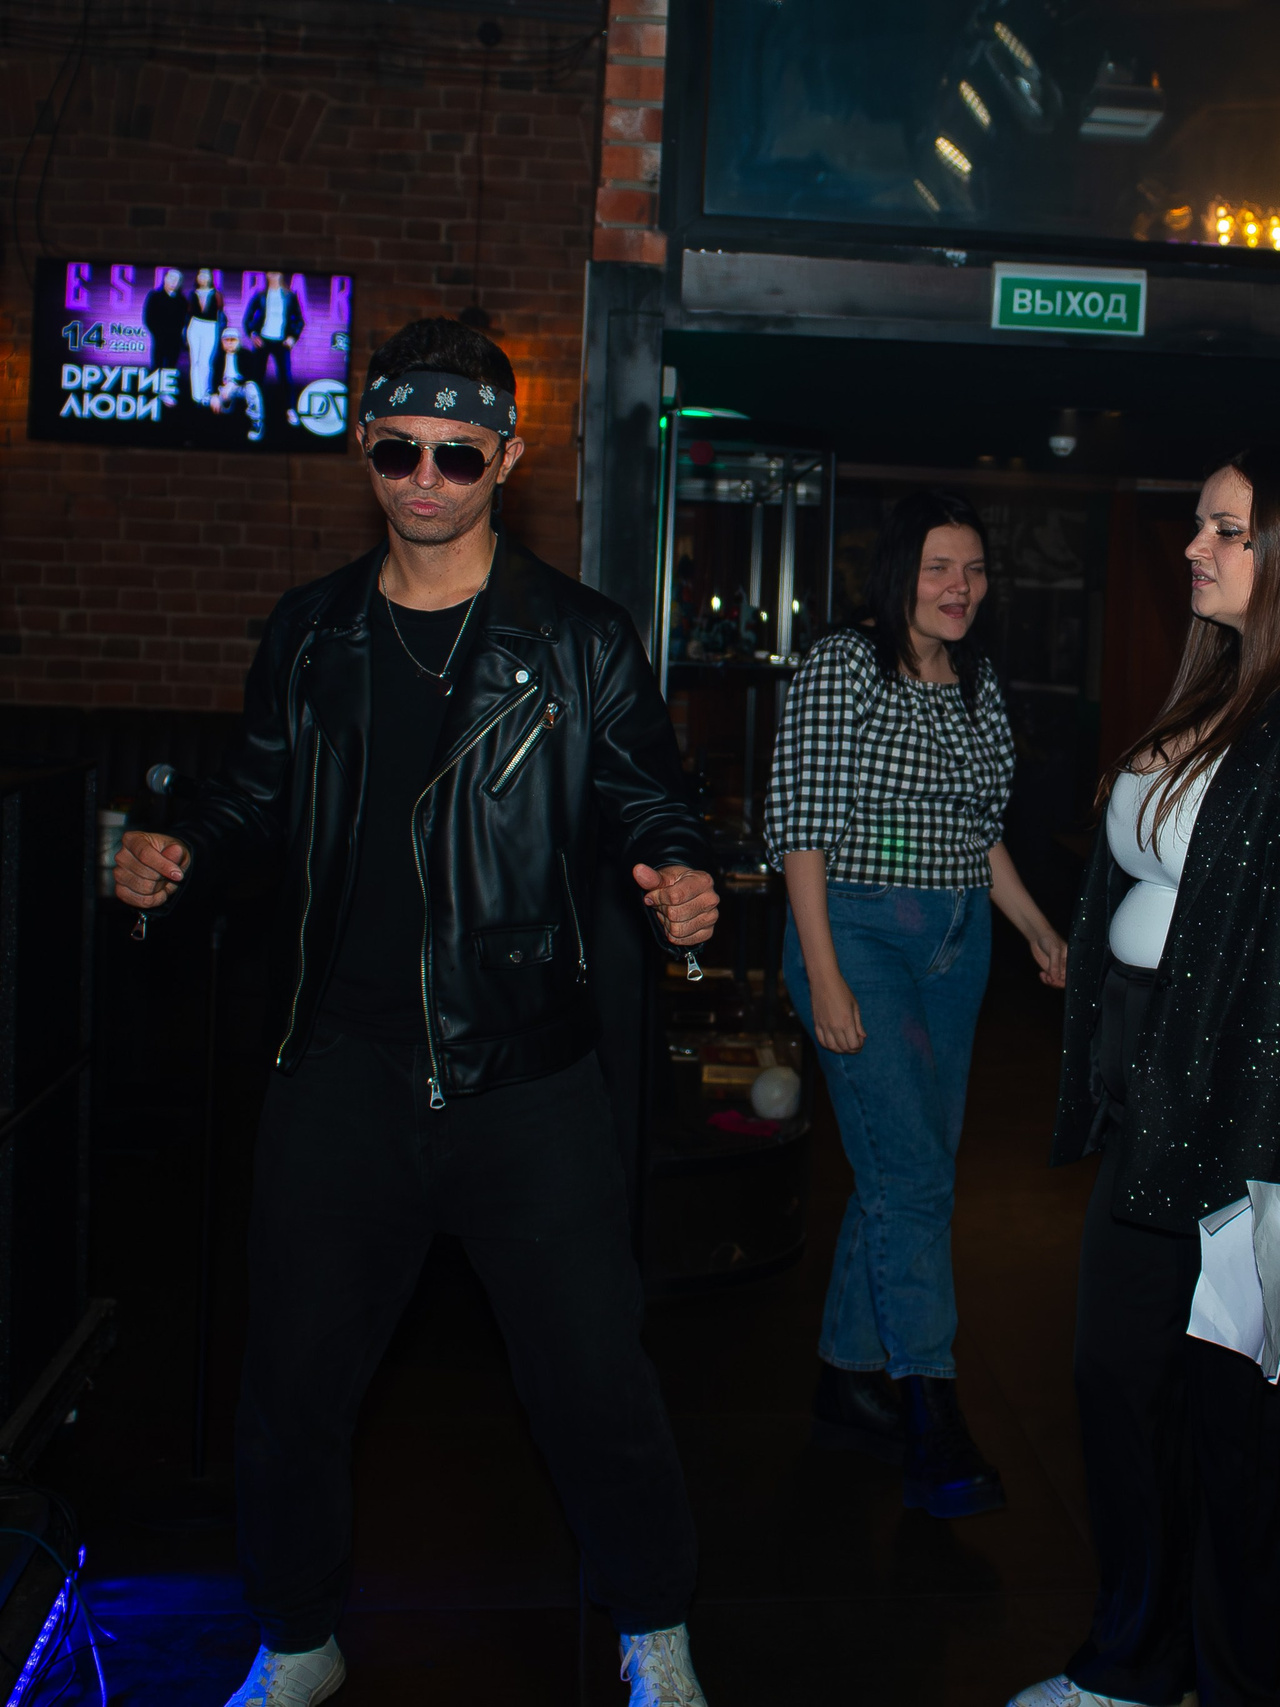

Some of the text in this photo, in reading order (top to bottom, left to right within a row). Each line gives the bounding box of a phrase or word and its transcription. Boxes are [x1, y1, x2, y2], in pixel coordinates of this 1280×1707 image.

[65, 262, 349, 324] ESAR
[1012, 287, 1127, 324] ВЫХОД
[62, 320, 106, 351] 14
[109, 340, 146, 352] 22:00
